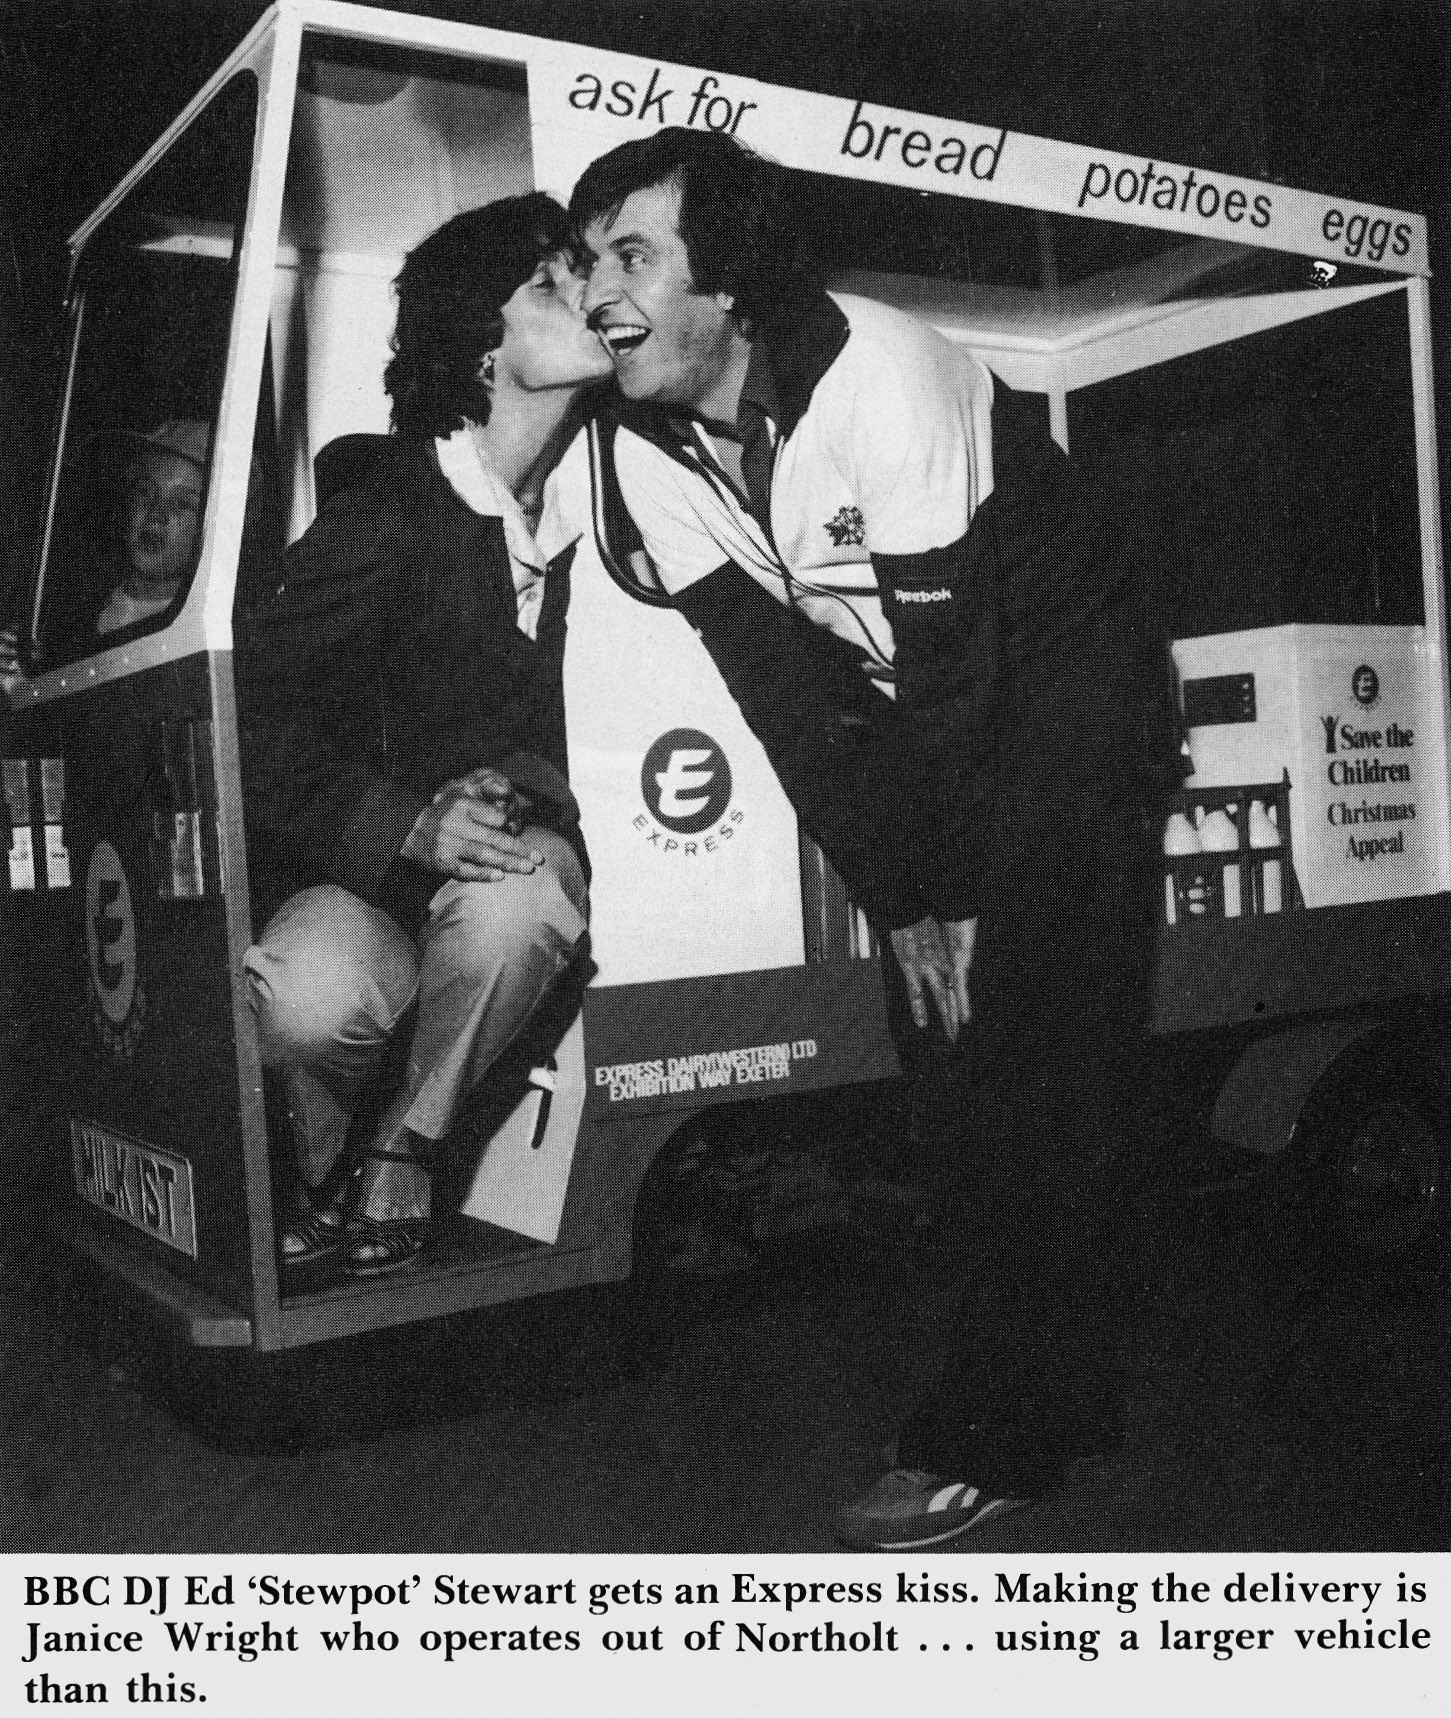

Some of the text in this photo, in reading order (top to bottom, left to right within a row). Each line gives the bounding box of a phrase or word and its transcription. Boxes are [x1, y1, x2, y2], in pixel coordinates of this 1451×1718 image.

[568, 67, 1414, 263] ask for bread potatoes eggs
[1340, 722, 1415, 751] Save the
[1327, 758, 1412, 787] Children
[1327, 799, 1418, 827] Christmas
[632, 809, 745, 857] EXPRESS
[1347, 830, 1405, 862] Appeal
[595, 1059, 665, 1087] EXPRESS
[791, 1039, 818, 1060] LTD
[609, 1061, 790, 1102] EXHIBITION WAY EXETER
